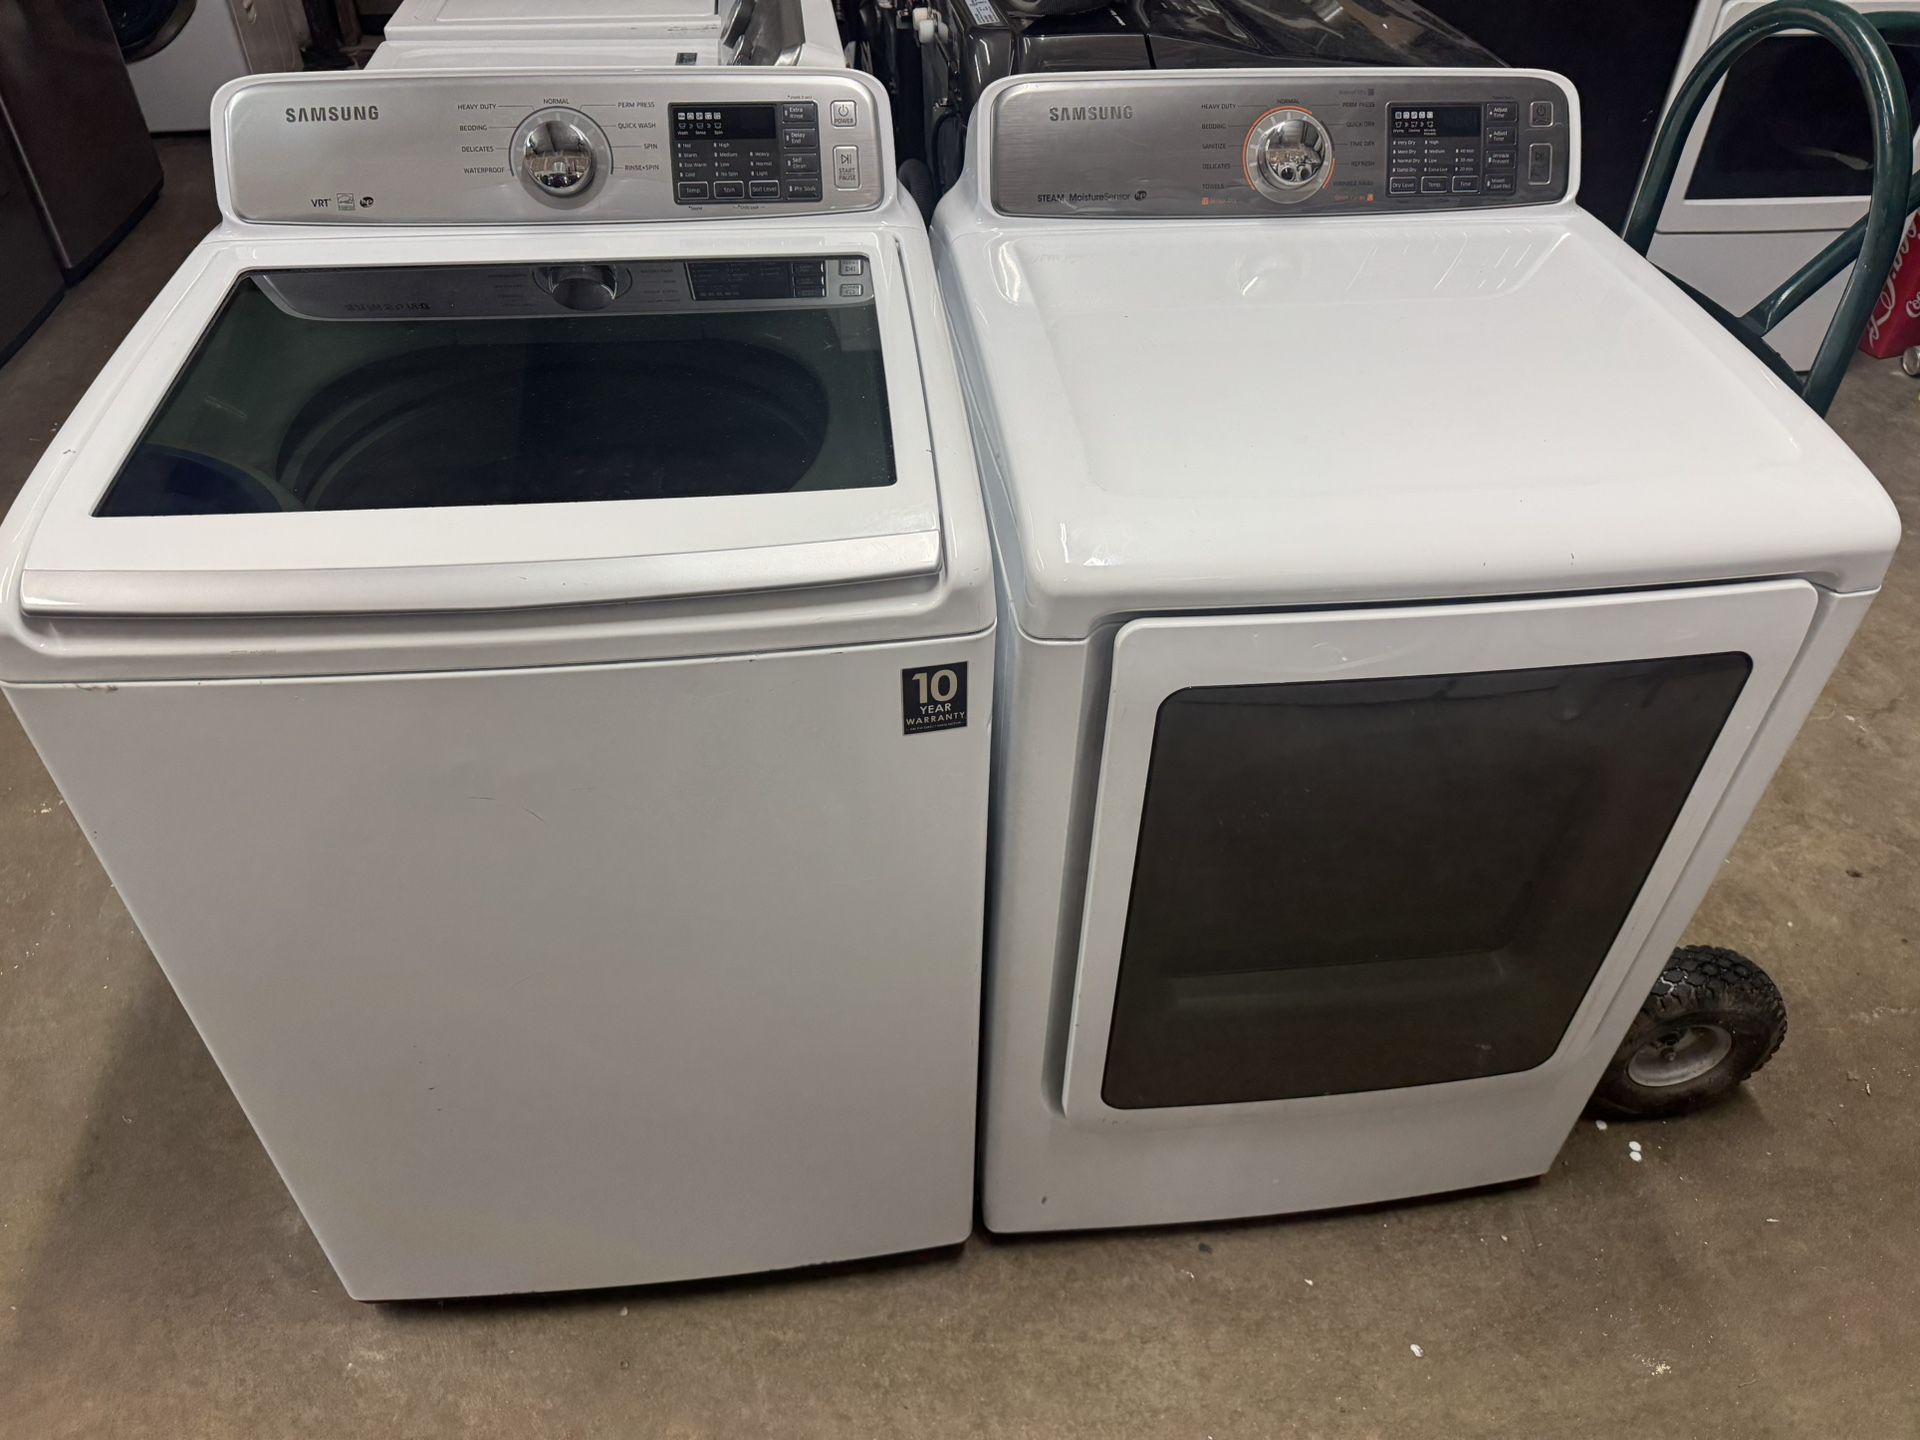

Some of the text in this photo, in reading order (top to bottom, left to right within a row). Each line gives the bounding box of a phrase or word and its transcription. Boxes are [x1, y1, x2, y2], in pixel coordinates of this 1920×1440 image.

[285, 105, 379, 123] SAMSUNG
[1049, 106, 1134, 122] SAMSUNG
[791, 132, 806, 140] Delay
[718, 141, 730, 150] High
[719, 150, 739, 158] Medium
[463, 166, 505, 174] WATERPROOF
[1037, 193, 1065, 203] STEAM
[912, 669, 958, 704] 10
[920, 702, 952, 715] YEAR
[906, 711, 966, 726] WARRANTY
